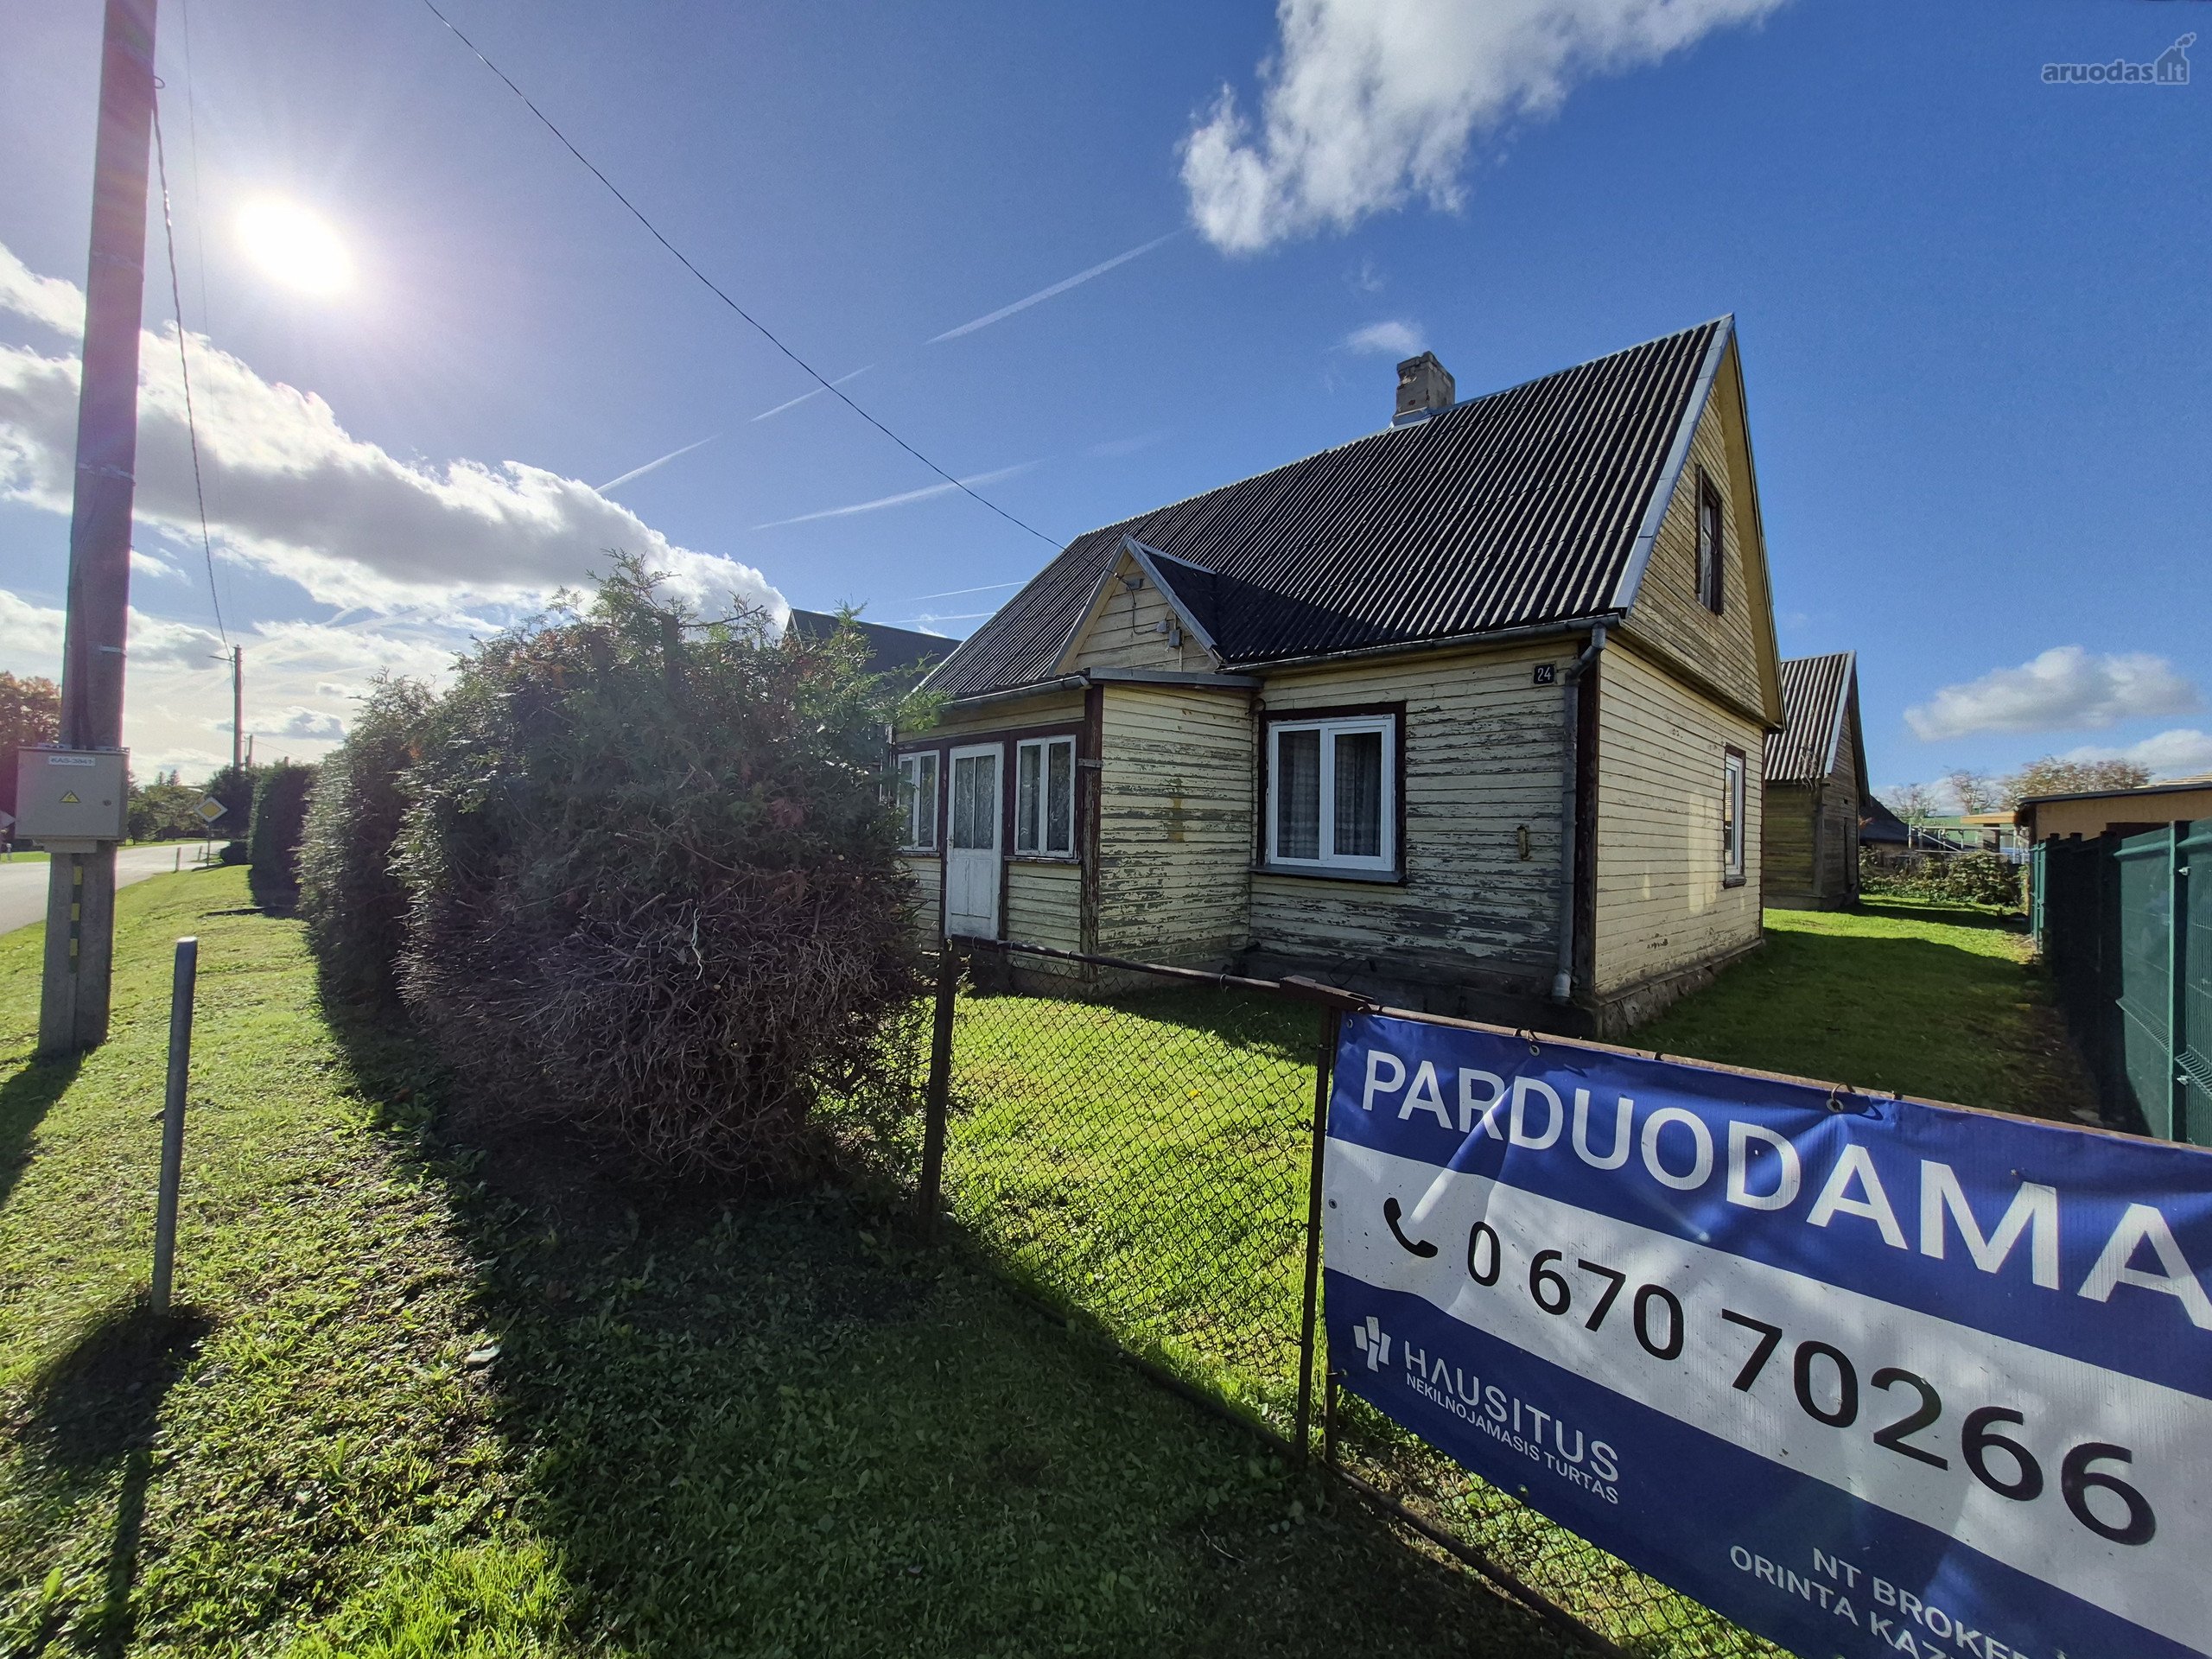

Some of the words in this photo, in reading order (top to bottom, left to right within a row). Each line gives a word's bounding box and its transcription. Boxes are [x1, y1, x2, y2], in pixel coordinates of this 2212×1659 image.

[1537, 666, 1552, 682] 24
[1362, 1049, 2212, 1332] PARDUODAMA
[1404, 1340, 1618, 1482] HAUSITUS
[1406, 1372, 1540, 1461] NEKILNOJAMASIS
[1543, 1451, 1618, 1504] TURTAS
[1468, 1221, 1501, 1287] 0
[1529, 1249, 1685, 1361] 670
[1721, 1308, 2156, 1547] 70266
[1730, 1544, 1859, 1626] ORINTA
[1813, 1547, 1861, 1588] NT
[1872, 1575, 2031, 1659] BROKE
